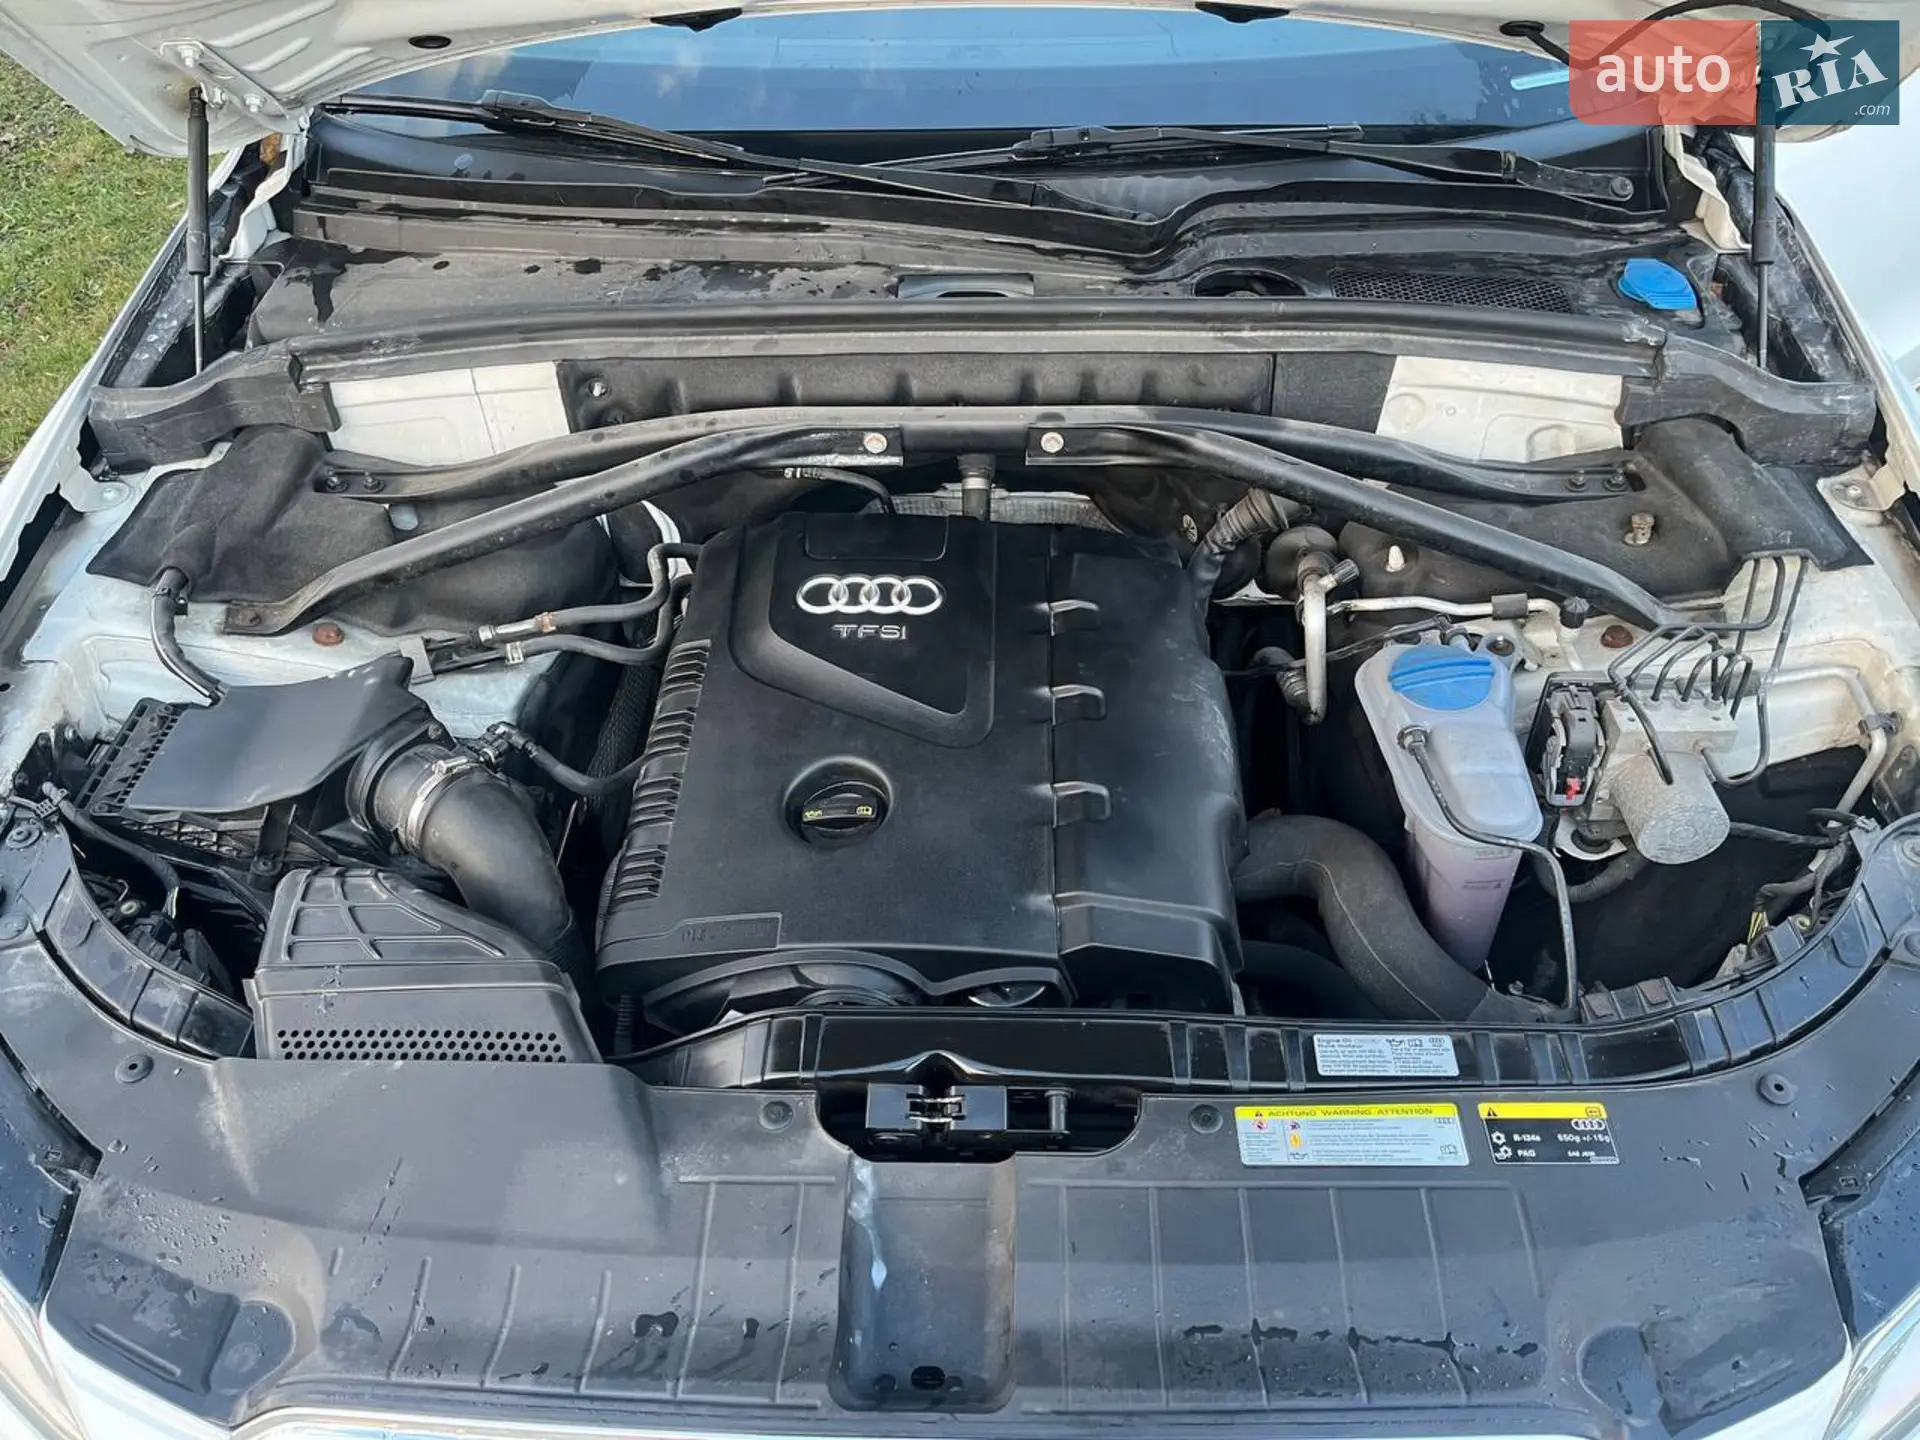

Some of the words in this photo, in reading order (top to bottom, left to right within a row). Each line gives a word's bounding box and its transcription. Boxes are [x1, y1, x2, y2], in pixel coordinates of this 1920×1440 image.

[832, 624, 906, 640] TFSI
[1268, 1110, 1317, 1118] ACHTUNG
[1321, 1108, 1372, 1117] WARNING
[1377, 1107, 1433, 1116] ATTENTION
